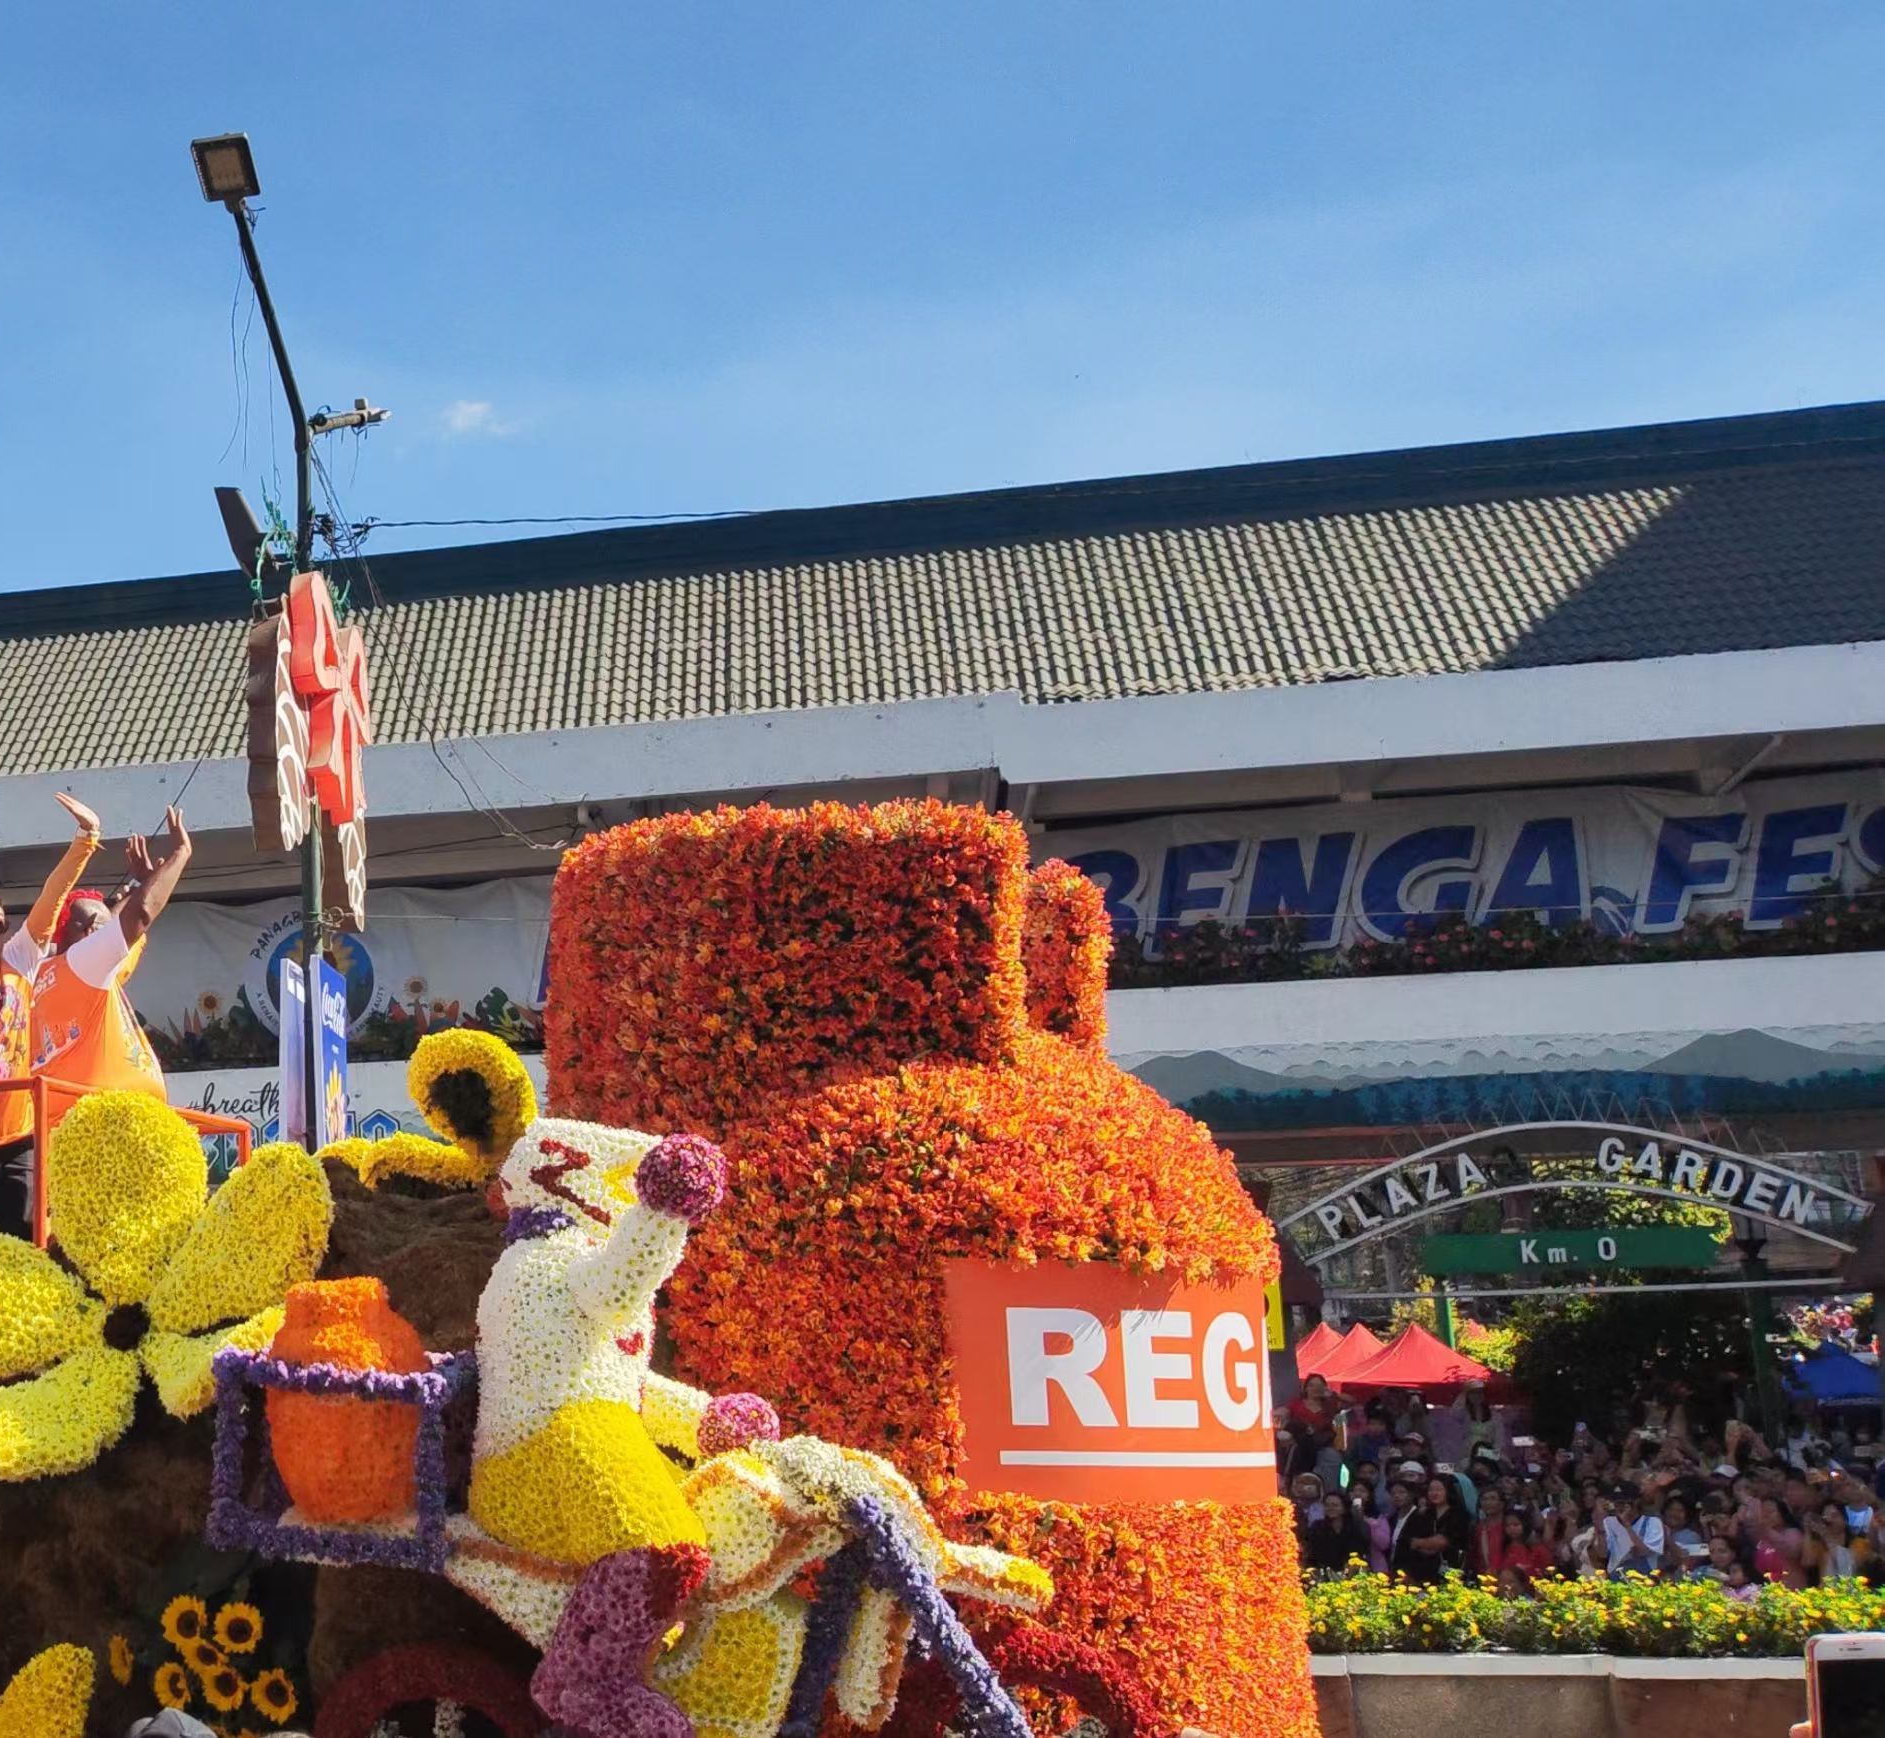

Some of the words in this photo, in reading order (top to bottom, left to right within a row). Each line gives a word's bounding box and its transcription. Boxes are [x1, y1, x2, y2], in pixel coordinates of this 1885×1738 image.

[1065, 817, 1589, 960] BENGA
[250, 909, 303, 960] PANAGB
[188, 1081, 280, 1120] #breath
[1317, 1152, 1488, 1241] PLAZA
[1598, 1137, 1815, 1225] GARDEN
[1521, 1239, 1579, 1264] Km.
[1006, 1306, 1272, 1432] REG
